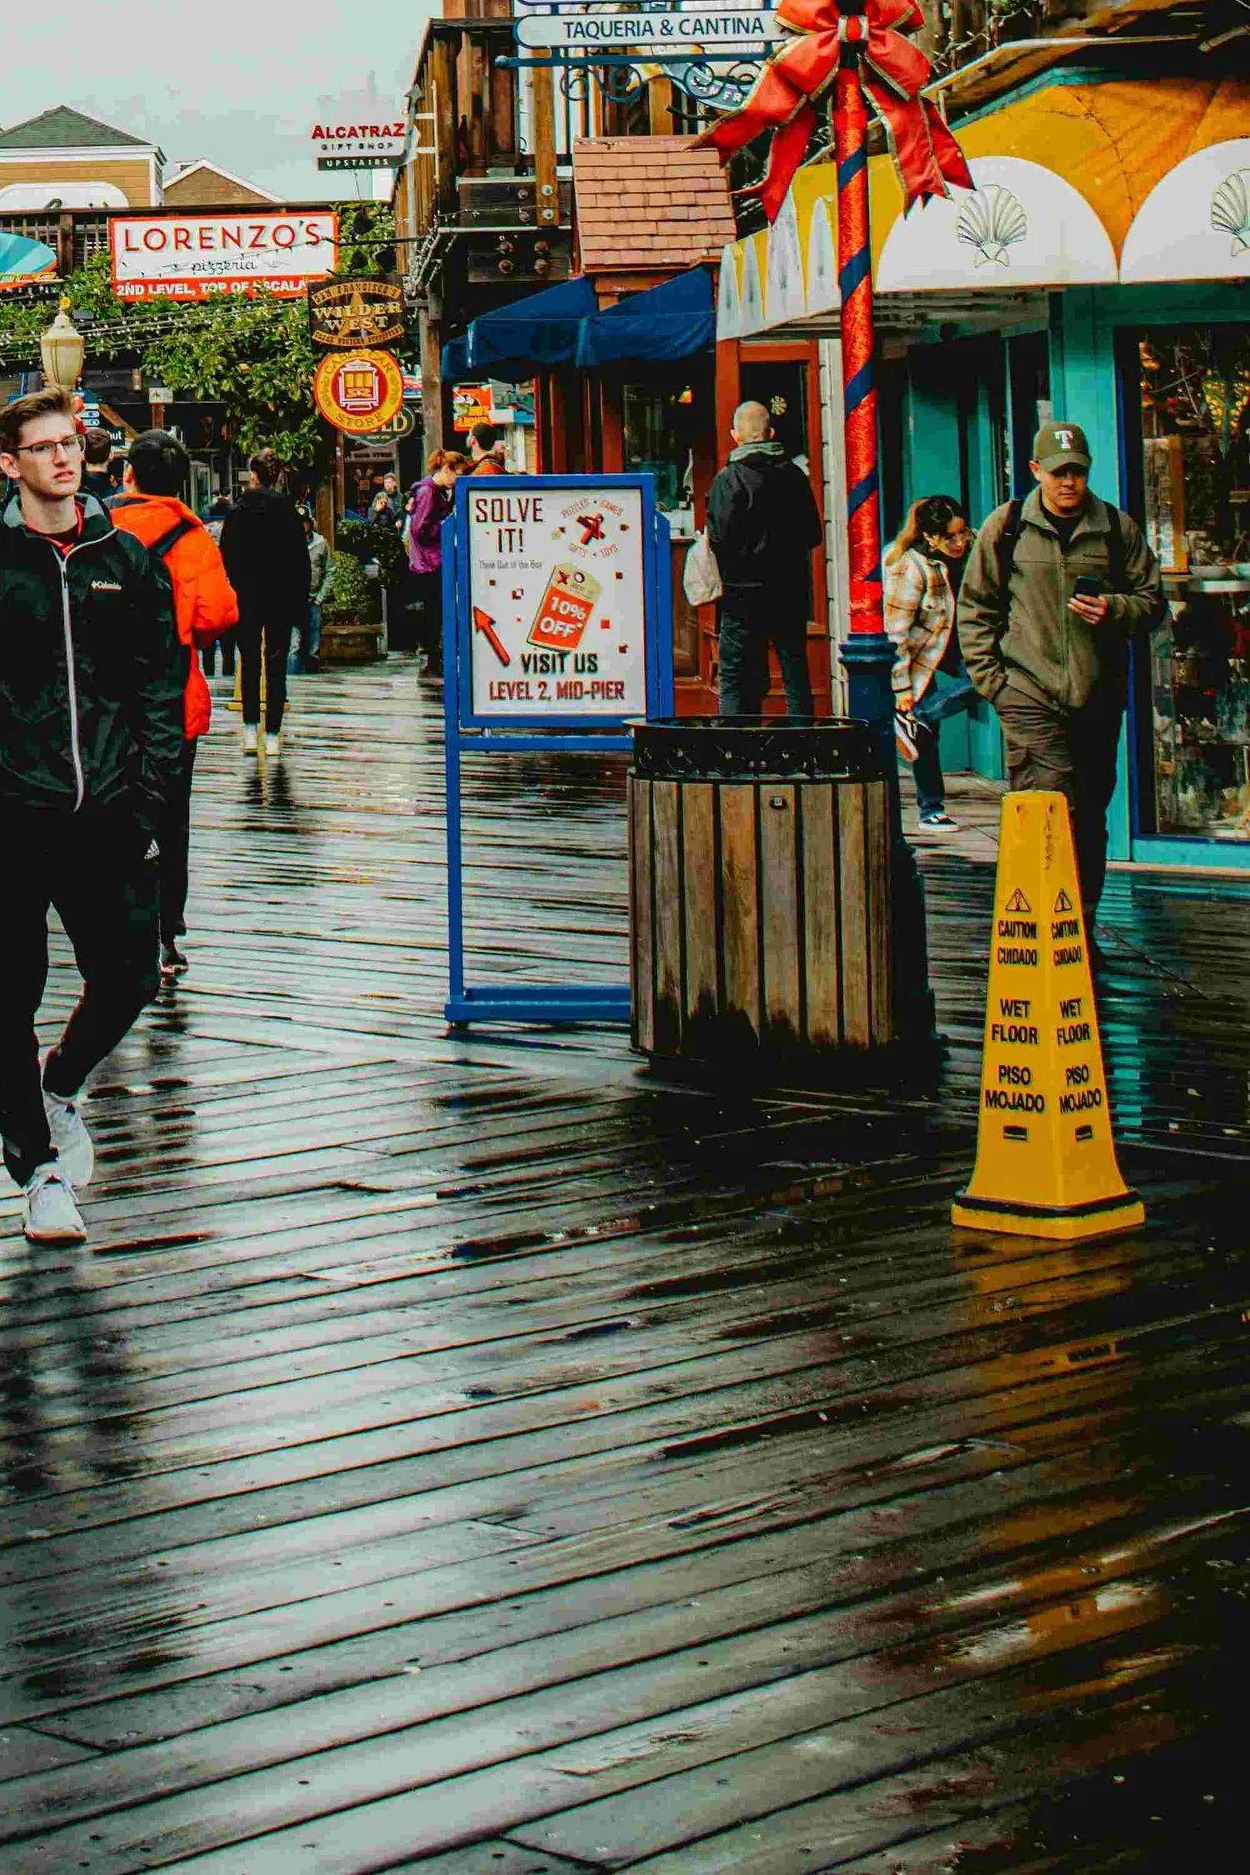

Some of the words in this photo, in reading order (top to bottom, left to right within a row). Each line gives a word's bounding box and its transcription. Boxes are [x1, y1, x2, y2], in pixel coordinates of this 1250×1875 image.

[563, 19, 654, 40] TAQUERIA
[660, 19, 674, 36] &
[679, 17, 765, 36] CANTINA
[311, 123, 406, 139] ALCATRAZ
[321, 143, 352, 151] GIFT
[358, 142, 394, 150] SHOP
[326, 158, 389, 167] UPSTAIRS
[125, 220, 321, 252] LORENZO'S
[192, 260, 256, 274] pizzeria
[117, 284, 144, 296] 2ND
[149, 282, 196, 295] LEVEL,
[199, 282, 226, 294] TOP
[230, 281, 249, 294] OF
[312, 301, 403, 322] WILDER
[323, 315, 389, 331] WEST
[336, 412, 384, 428] STORE
[1054, 430, 1074, 449] T
[475, 497, 543, 522] SOLVE
[560, 498, 591, 519] PUZZLES
[498, 528, 524, 553] IT!
[551, 596, 586, 620] 10%
[521, 652, 569, 674] VISIT
[574, 652, 599, 674] US
[490, 681, 533, 700] LEVEL
[556, 681, 625, 700] MID-PIER
[998, 920, 1037, 939] CAUTION
[1052, 918, 1079, 939] CAUTION
[997, 947, 1037, 965] CUIDADO
[1054, 946, 1081, 966] CUIDADO
[1000, 999, 1030, 1018] WET
[1060, 998, 1081, 1019] WET
[991, 1024, 1038, 1045] FLOOR
[1057, 1023, 1090, 1046] FLOOR
[998, 1065, 1031, 1085] PISO
[1066, 1064, 1089, 1087] PISO
[985, 1089, 1045, 1112] MOJADO
[1059, 1088, 1102, 1115] MOJADO
